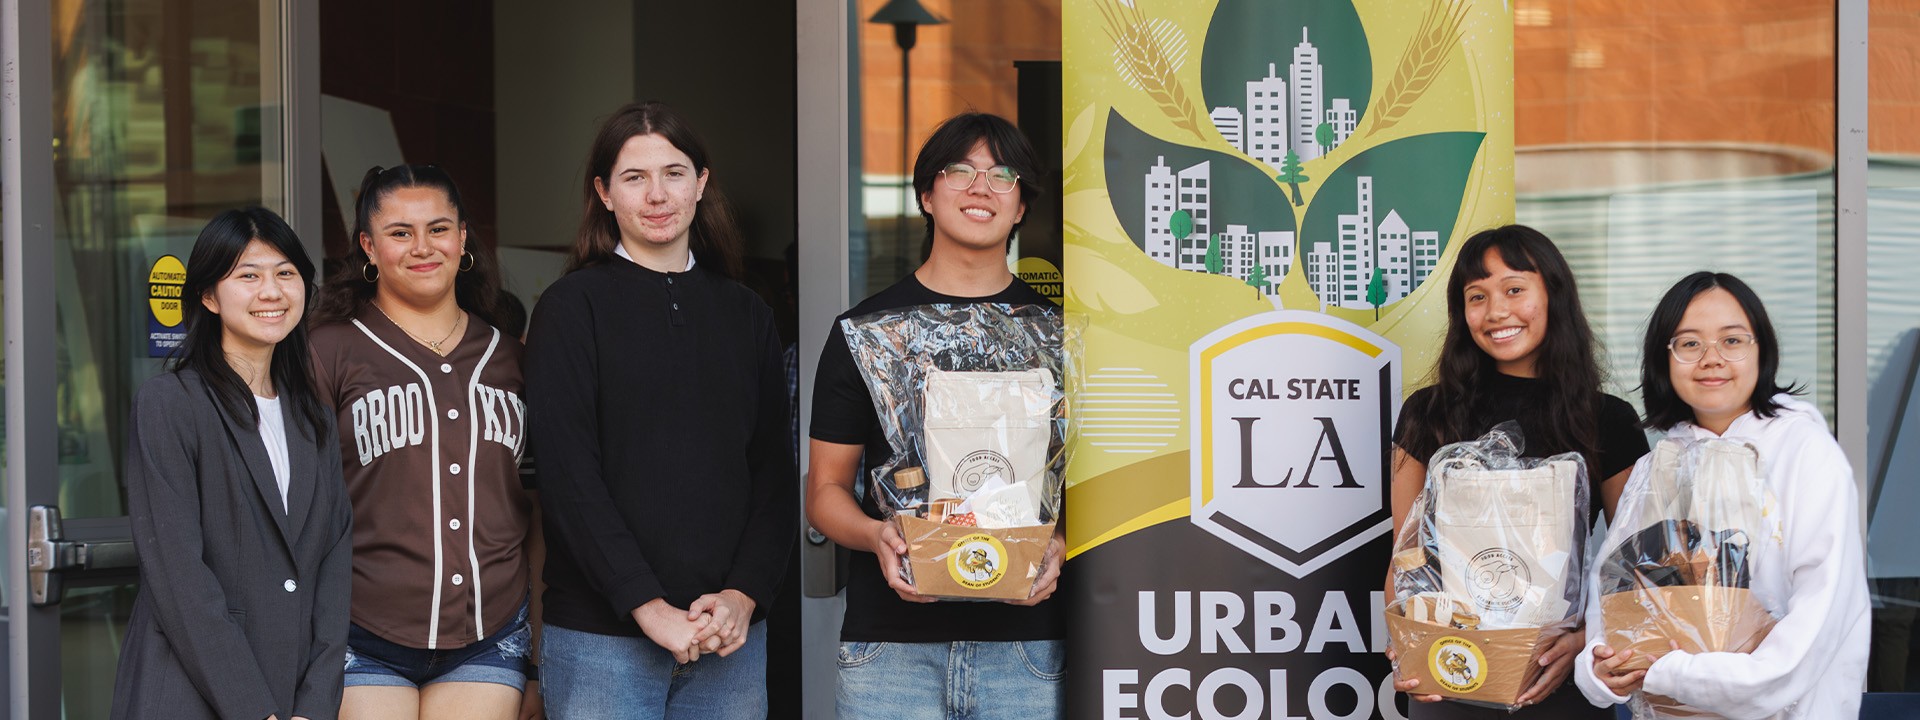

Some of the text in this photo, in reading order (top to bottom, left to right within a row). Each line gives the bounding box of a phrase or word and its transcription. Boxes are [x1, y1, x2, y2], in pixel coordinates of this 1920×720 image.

[152, 271, 186, 281] AUTOMATIC
[1017, 271, 1059, 280] TOMATIC
[151, 285, 183, 297] CAUTIO
[1030, 284, 1061, 295] TION
[161, 301, 178, 310] DOOR
[1228, 378, 1361, 400] CAL STATE
[1231, 417, 1365, 488] LA
